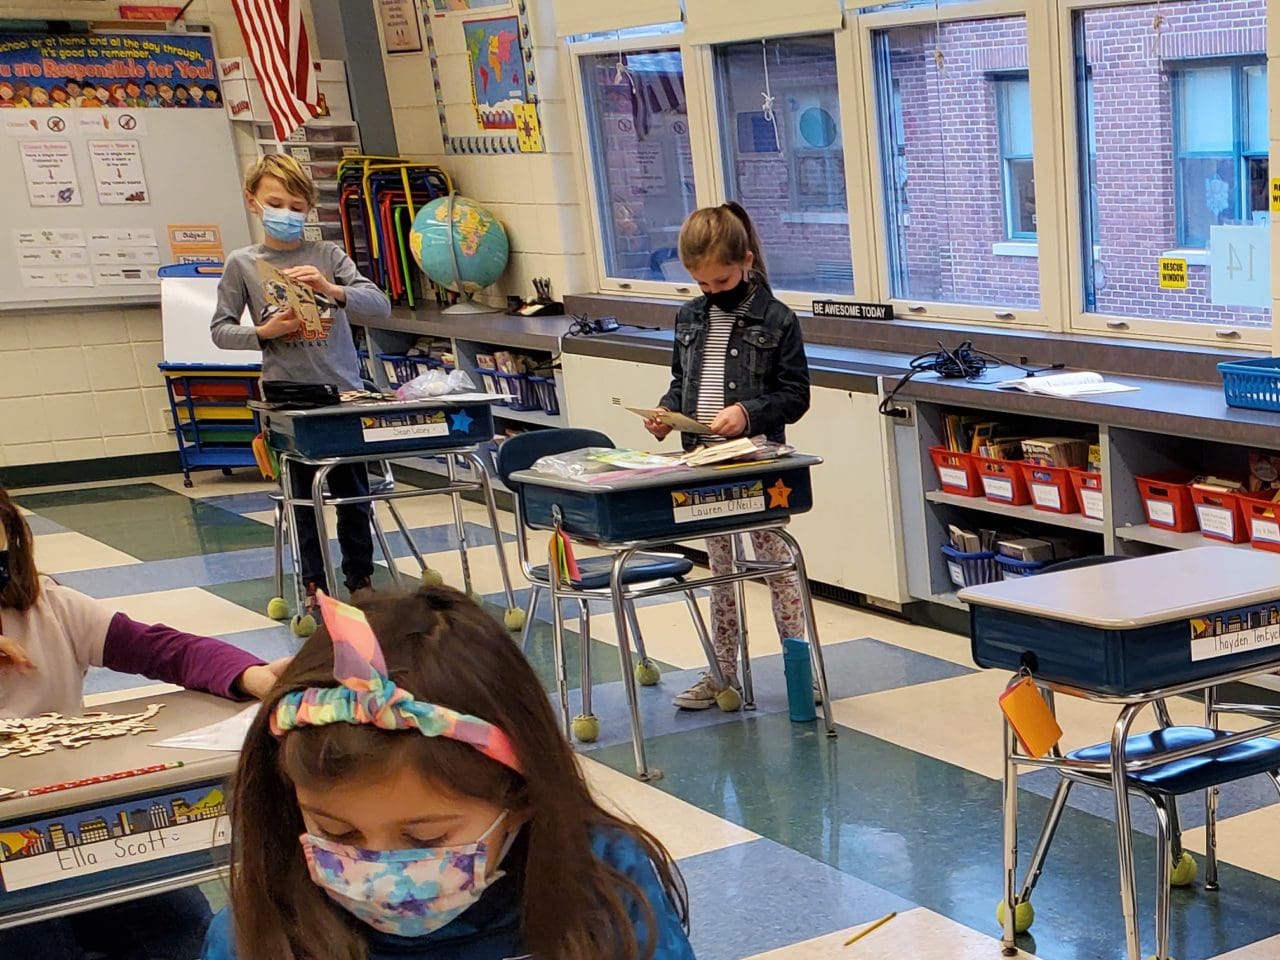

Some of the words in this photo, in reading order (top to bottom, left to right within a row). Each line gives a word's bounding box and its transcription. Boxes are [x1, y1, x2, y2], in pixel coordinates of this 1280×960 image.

[59, 37, 87, 47] home
[42, 58, 146, 80] Responsible
[147, 60, 174, 78] for
[174, 60, 214, 80] You!
[1162, 262, 1184, 272] RESCUE
[1162, 273, 1185, 283] WINDOW
[814, 303, 825, 314] BE
[824, 304, 861, 317] AWESOME
[861, 306, 886, 318] TODAY
[691, 503, 723, 517] Lauren
[57, 844, 98, 871] Ella
[114, 830, 167, 859] Scott
